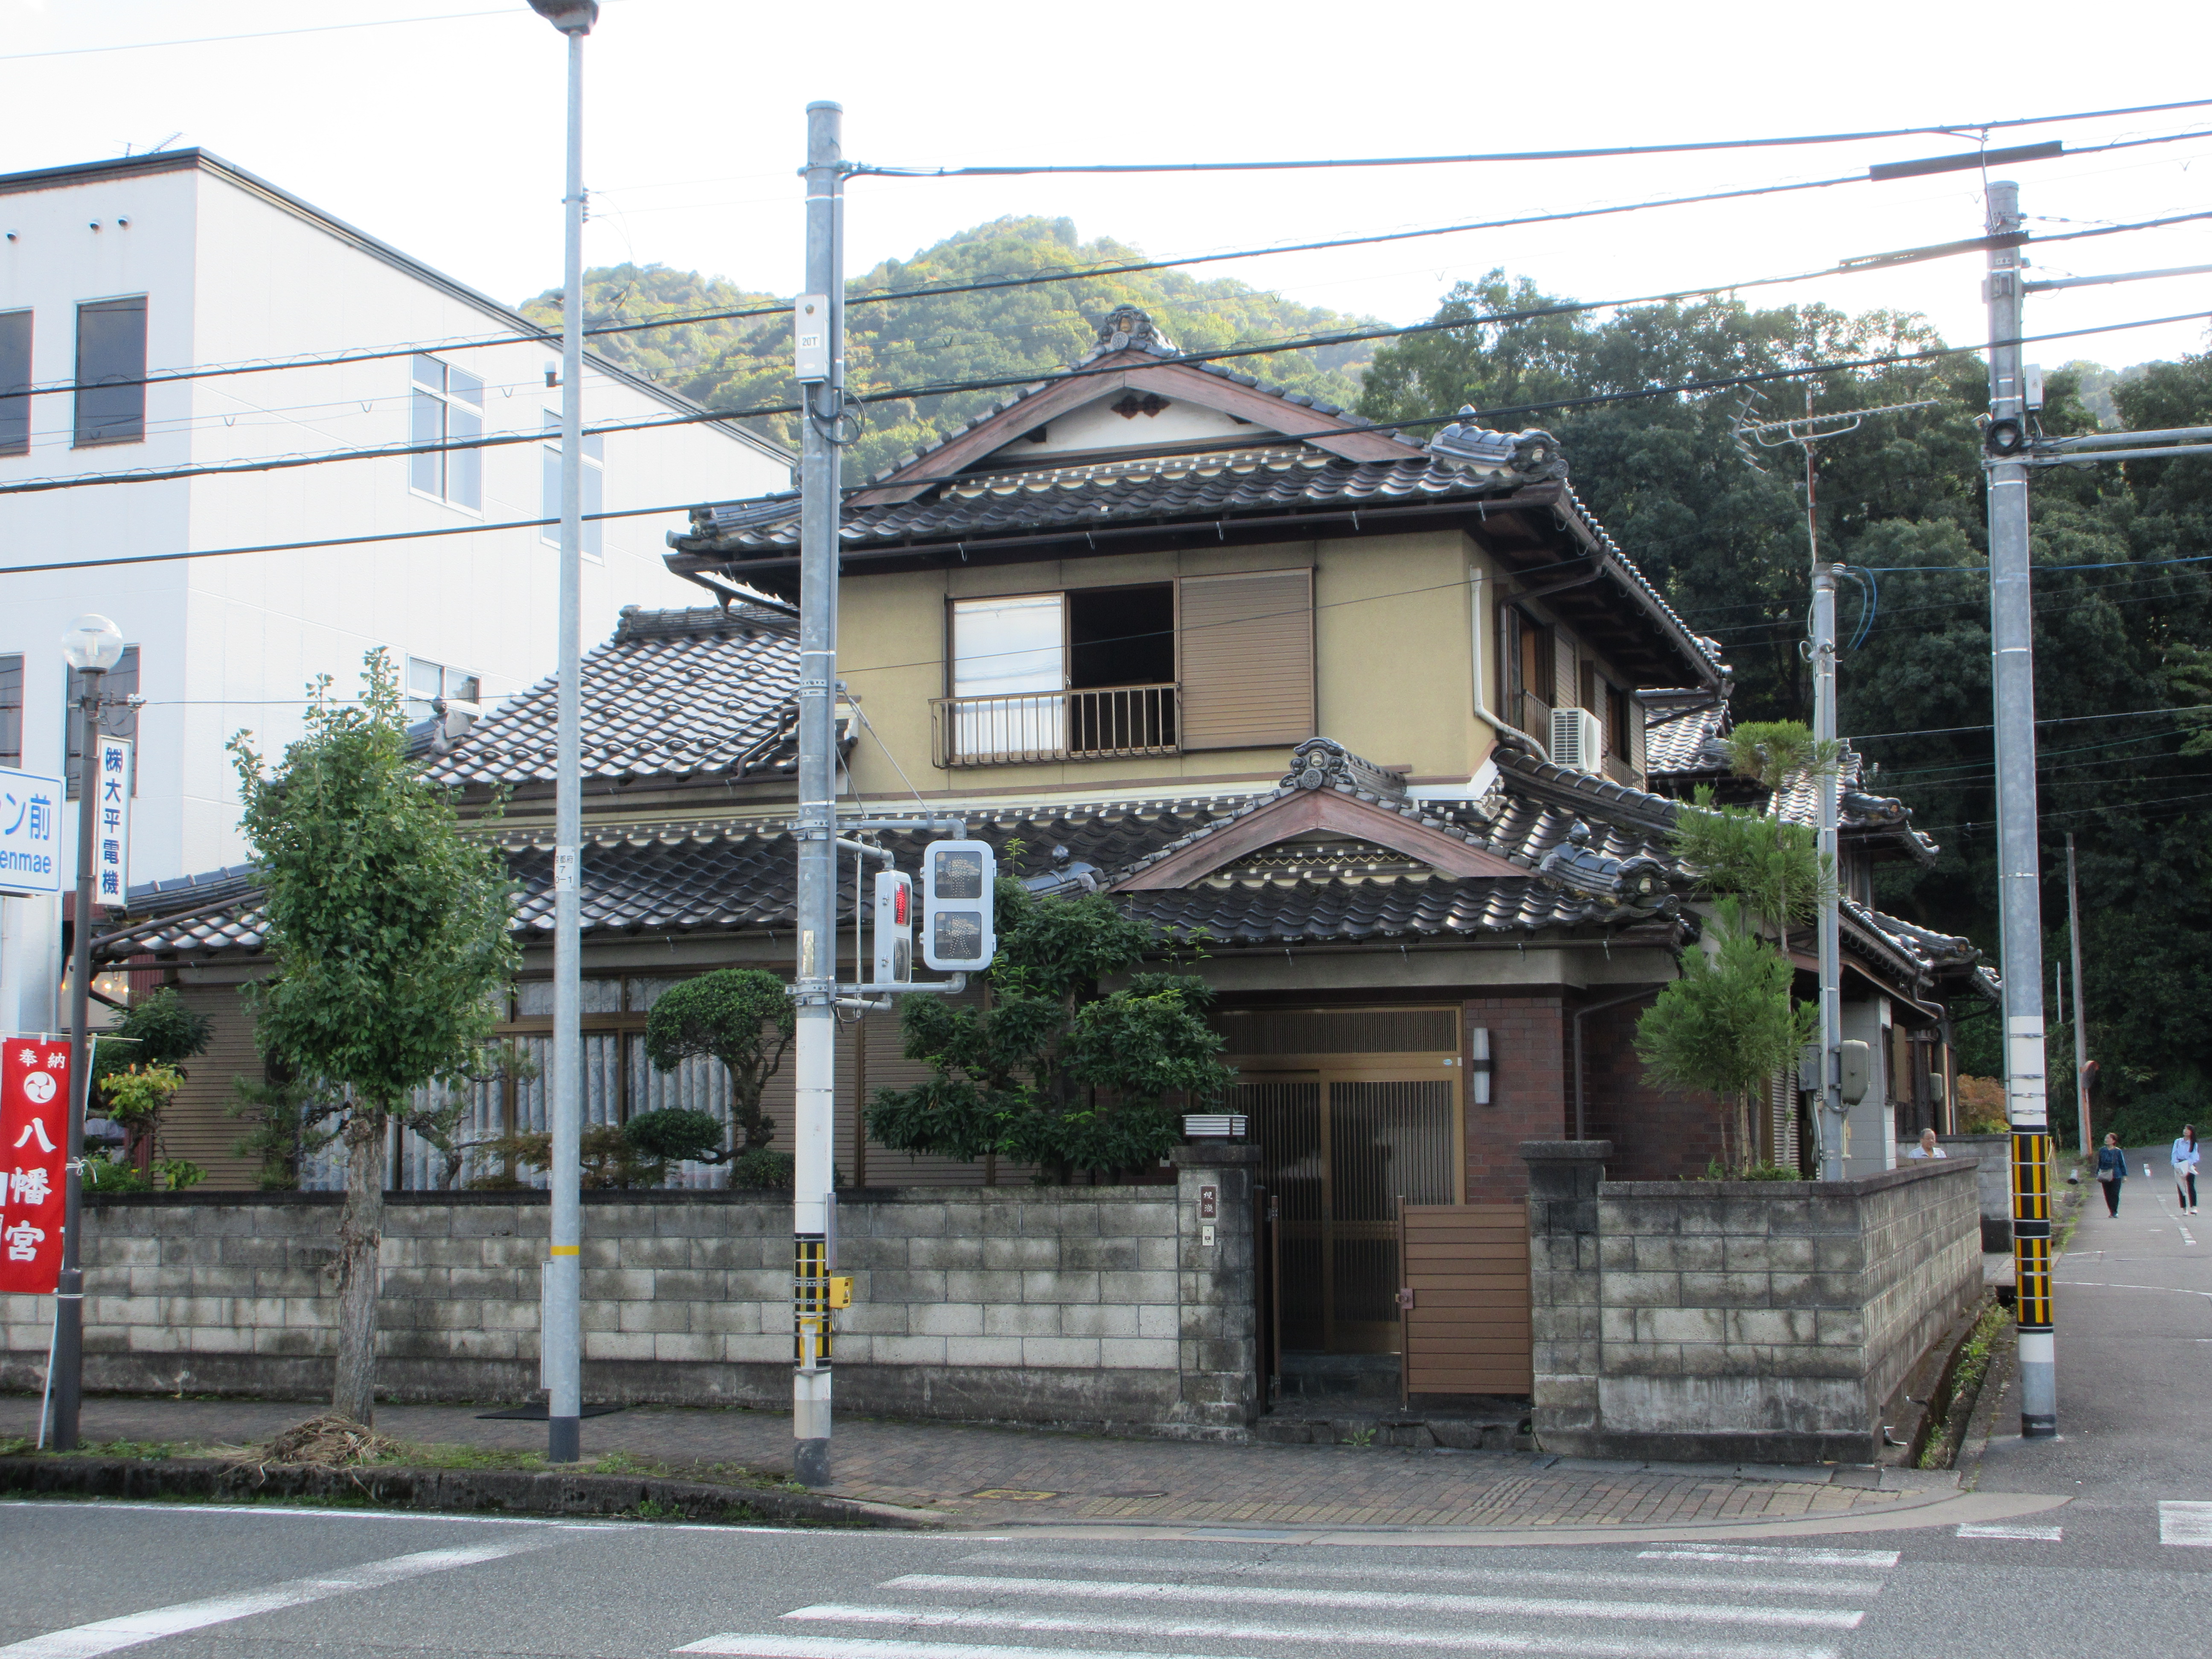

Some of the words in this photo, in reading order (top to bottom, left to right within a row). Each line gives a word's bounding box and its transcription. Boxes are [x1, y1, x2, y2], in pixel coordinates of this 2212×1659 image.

[802, 336, 818, 346] 20T
[0, 792, 52, 841] ン前
[19, 1048, 66, 1069] 奉納
[5, 1117, 57, 1262] 八幡宮
